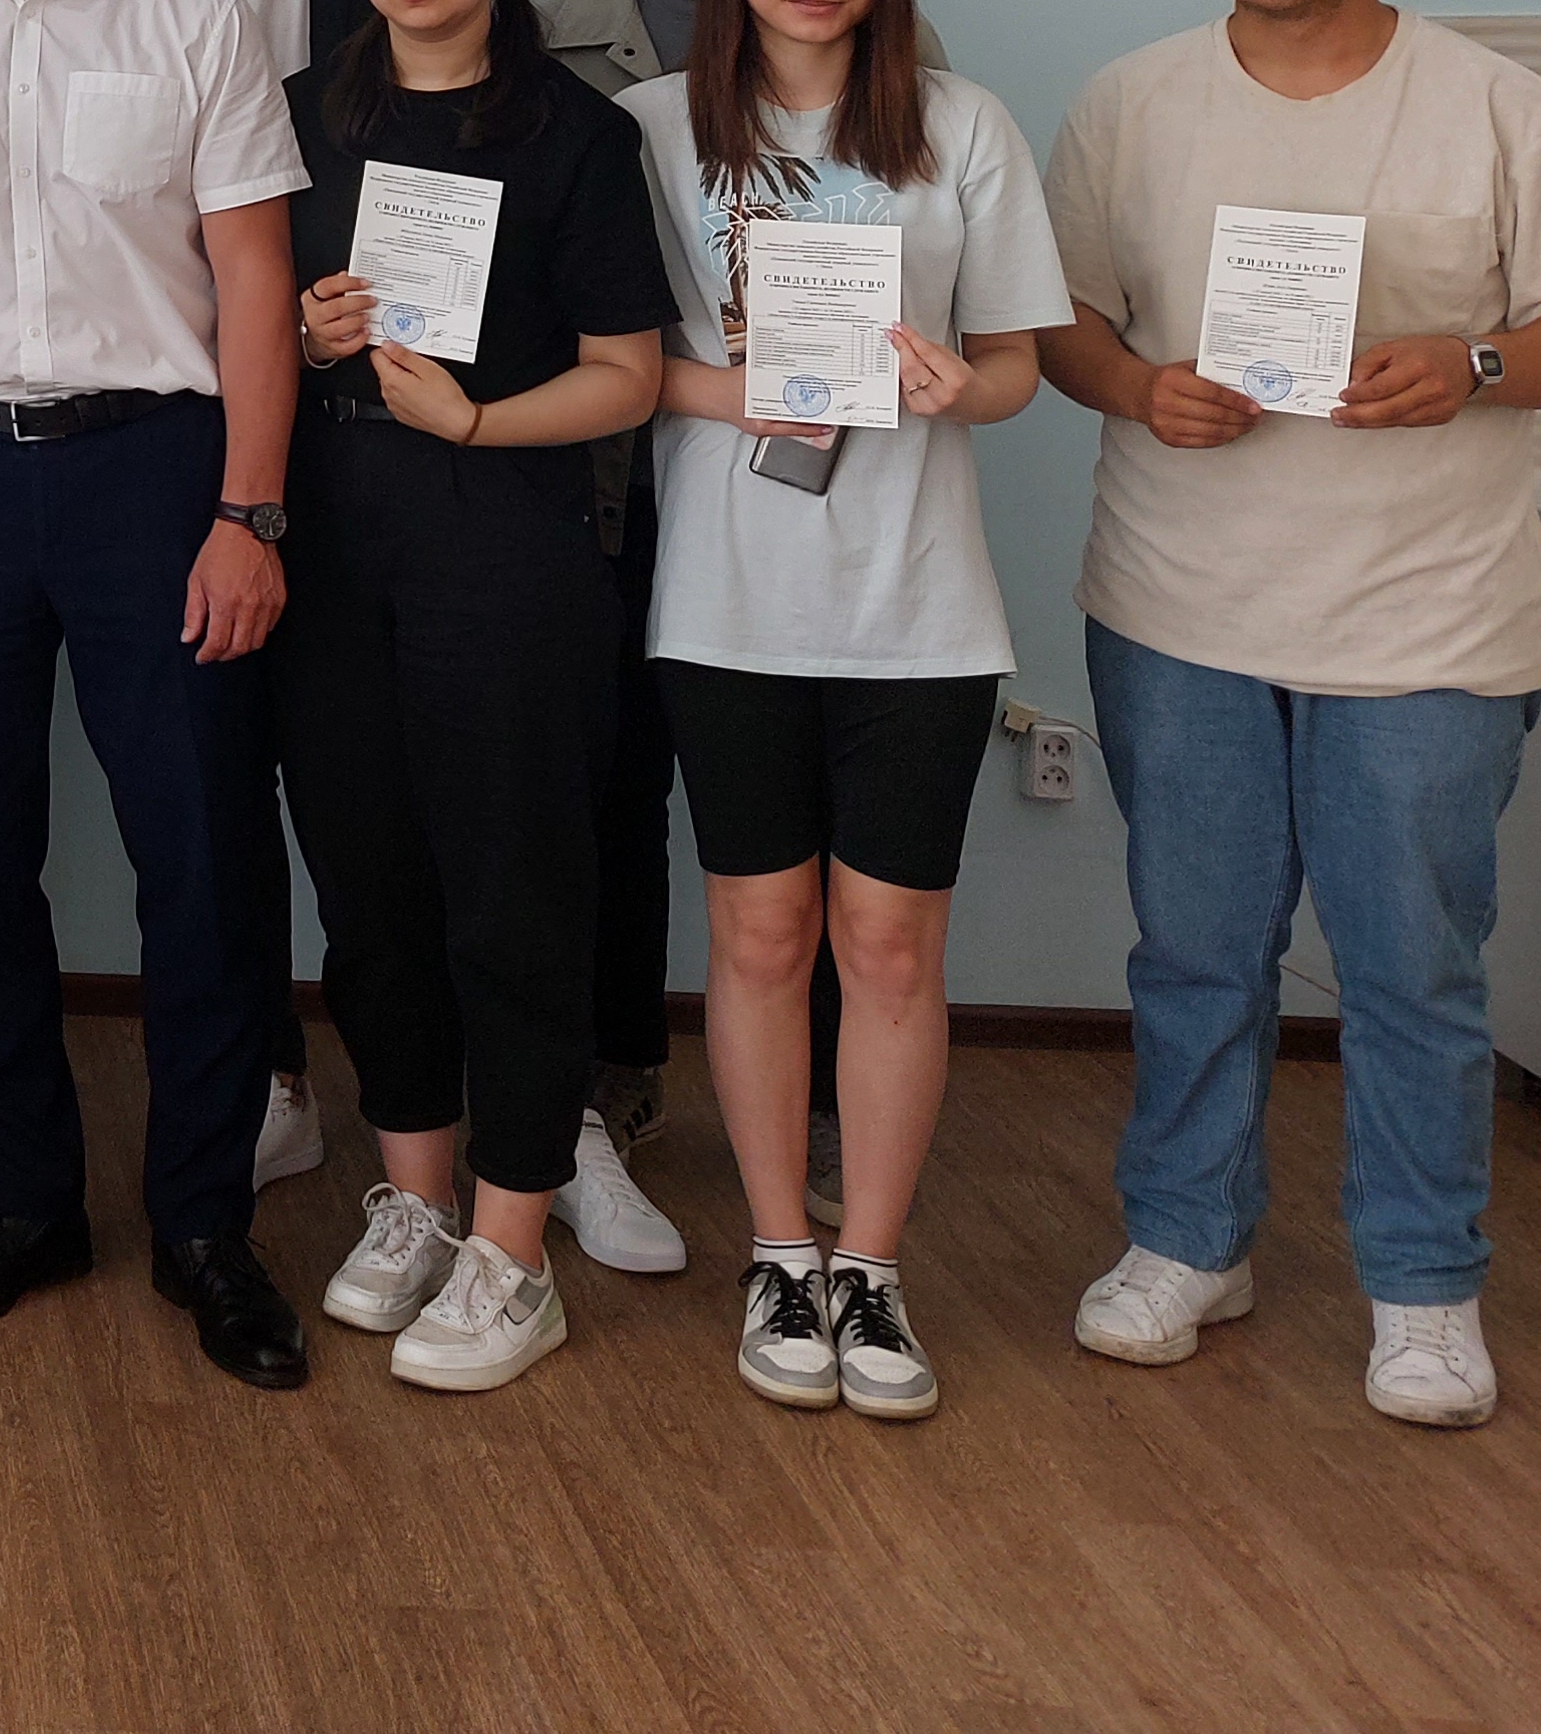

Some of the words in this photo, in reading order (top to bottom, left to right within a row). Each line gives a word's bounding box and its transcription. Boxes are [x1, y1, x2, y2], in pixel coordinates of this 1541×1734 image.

[708, 192, 759, 211] BEACH
[374, 201, 487, 227] СВИДЕТЕЛЬСТВО
[1227, 256, 1347, 274] СВИДЕТЕЛЬСТВО
[763, 274, 886, 289] СВИДЕТЕЛЬСТВО
